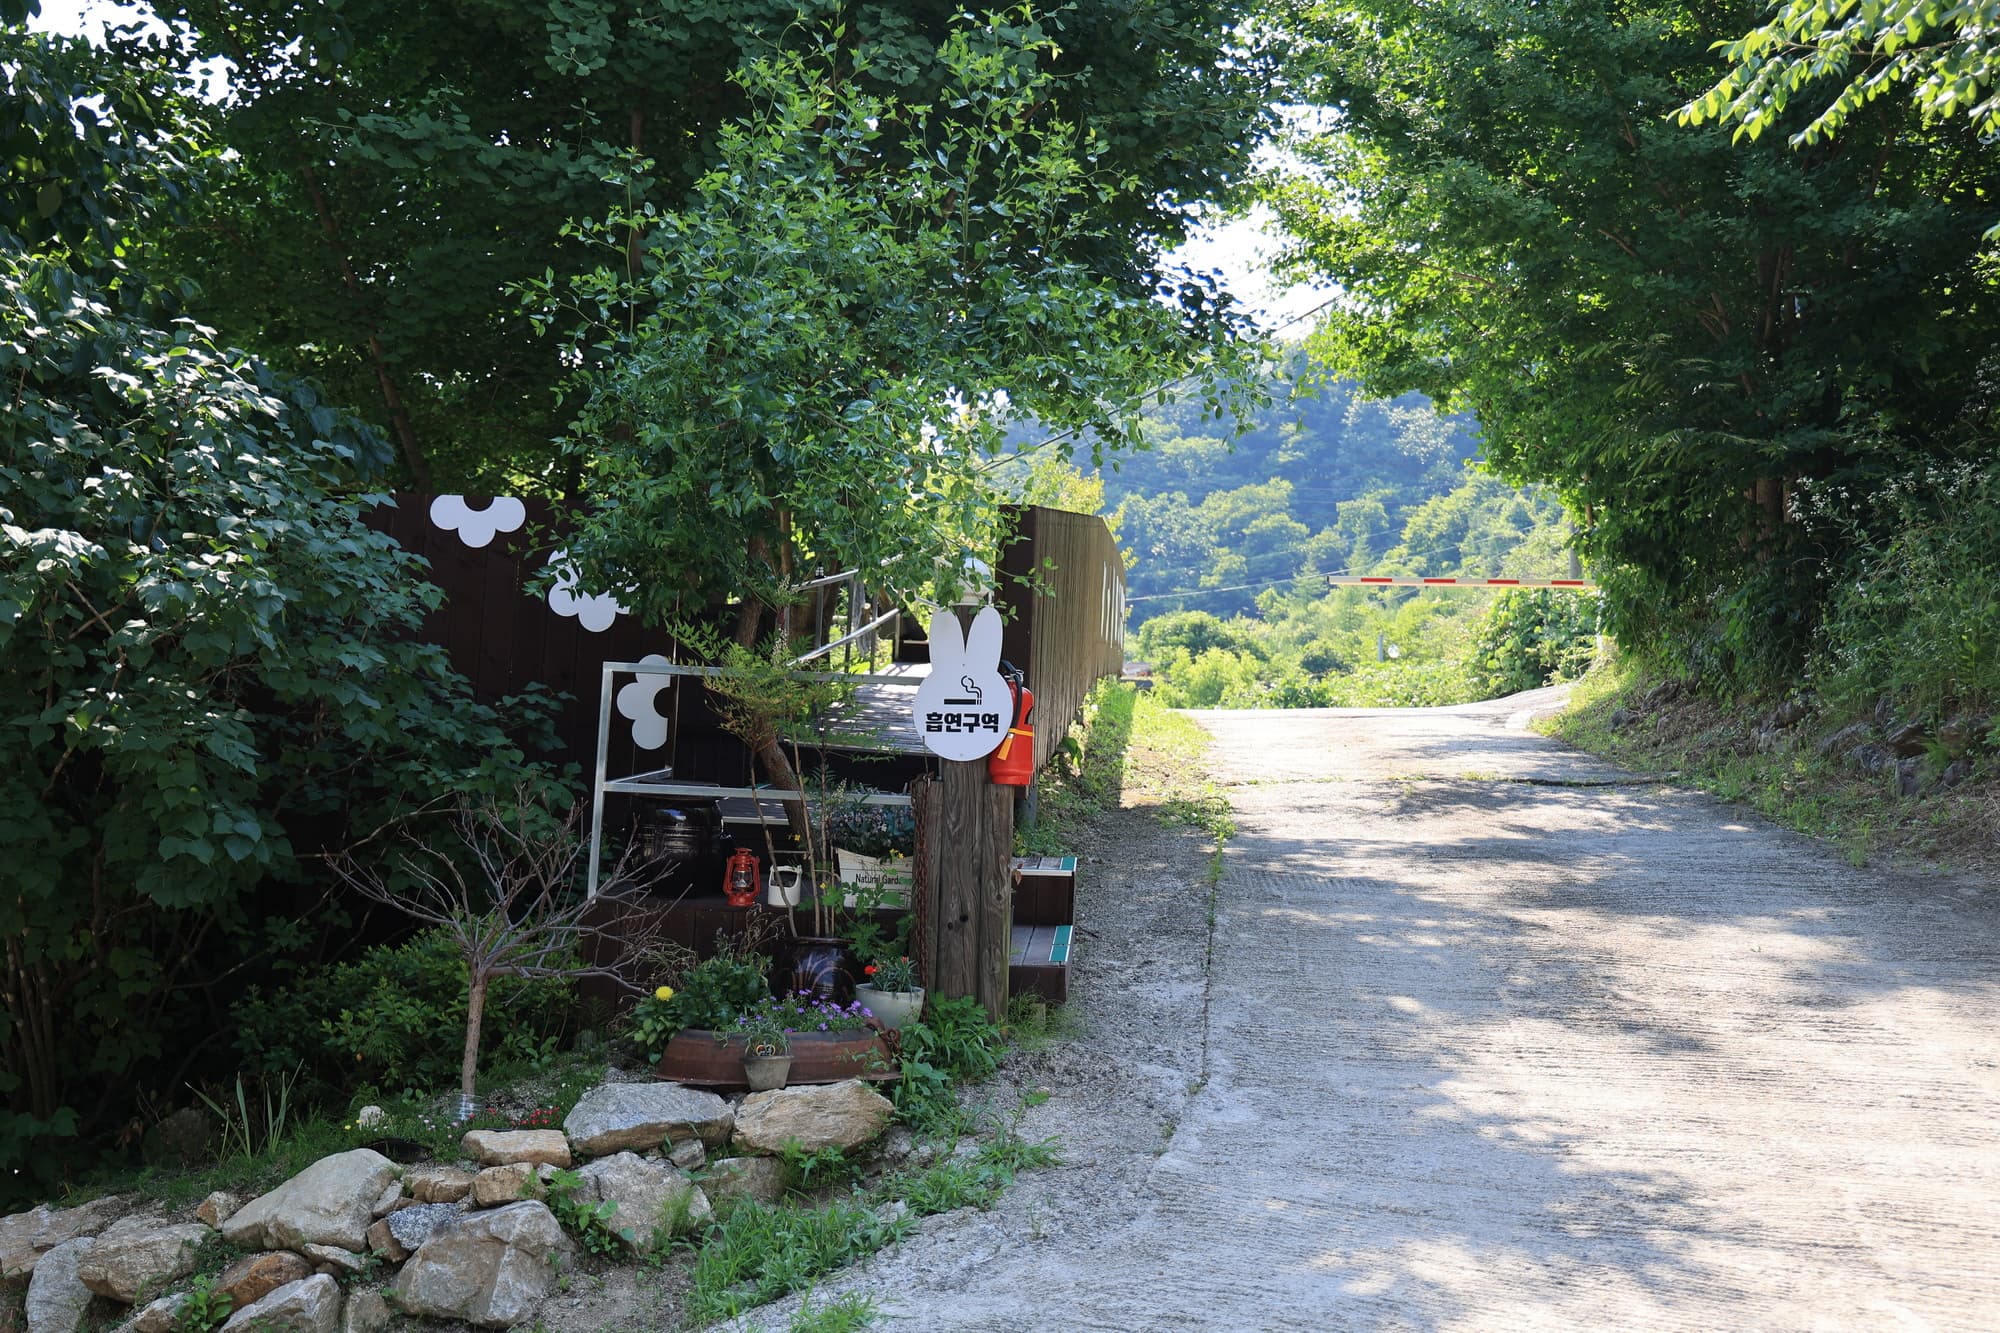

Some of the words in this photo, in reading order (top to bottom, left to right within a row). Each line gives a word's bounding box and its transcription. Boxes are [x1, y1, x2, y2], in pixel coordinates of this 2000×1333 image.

[925, 712, 999, 733] 흡연구역
[855, 873, 881, 884] Natural
[882, 874, 901, 885] Gard
